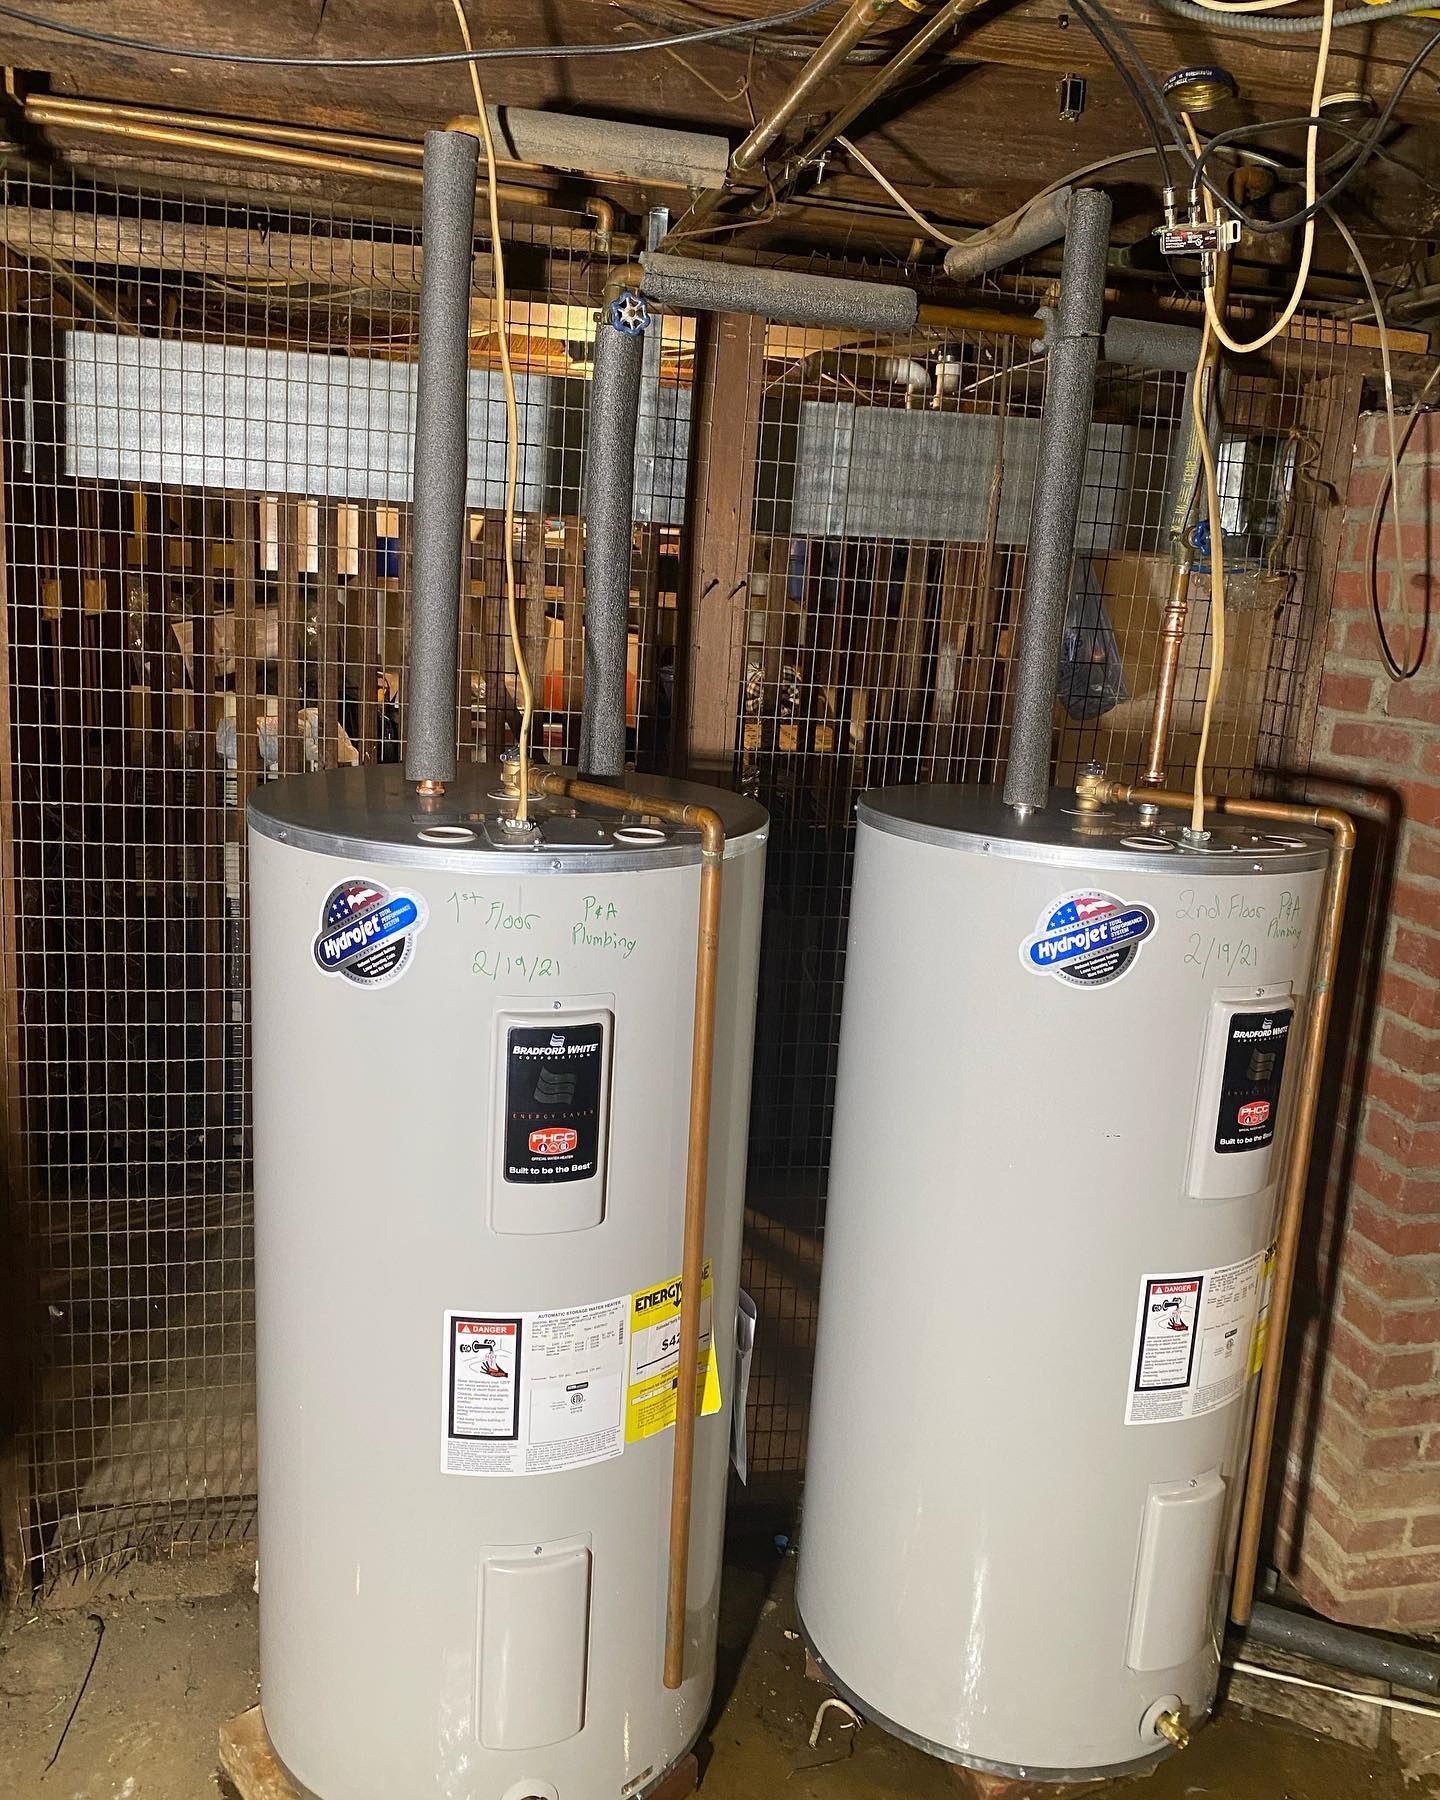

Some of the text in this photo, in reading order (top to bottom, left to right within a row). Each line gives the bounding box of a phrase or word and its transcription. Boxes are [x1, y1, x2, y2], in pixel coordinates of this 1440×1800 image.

[447, 892, 541, 930] 1st Floor
[1176, 889, 1266, 920] 2nd Floor
[1110, 915, 1143, 933] PERFORMANCE
[1111, 927, 1129, 938] SYSTEM
[323, 914, 381, 960] Hydrojet
[572, 922, 637, 959] Plumbing
[1038, 923, 1108, 960] Hydrojet
[1184, 933, 1257, 979] 2/19/21
[472, 950, 561, 983] 2/19/21
[1233, 1029, 1272, 1039] BRADFORD
[512, 1043, 597, 1056] BRADFORD WHITE
[532, 1132, 576, 1143] PHCC
[509, 1166, 529, 1175] Built
[530, 1167, 540, 1175] to
[541, 1166, 552, 1174] be
[555, 1165, 569, 1173] the
[1164, 1285, 1192, 1293] DANGER
[472, 1325, 507, 1334] DANGER
